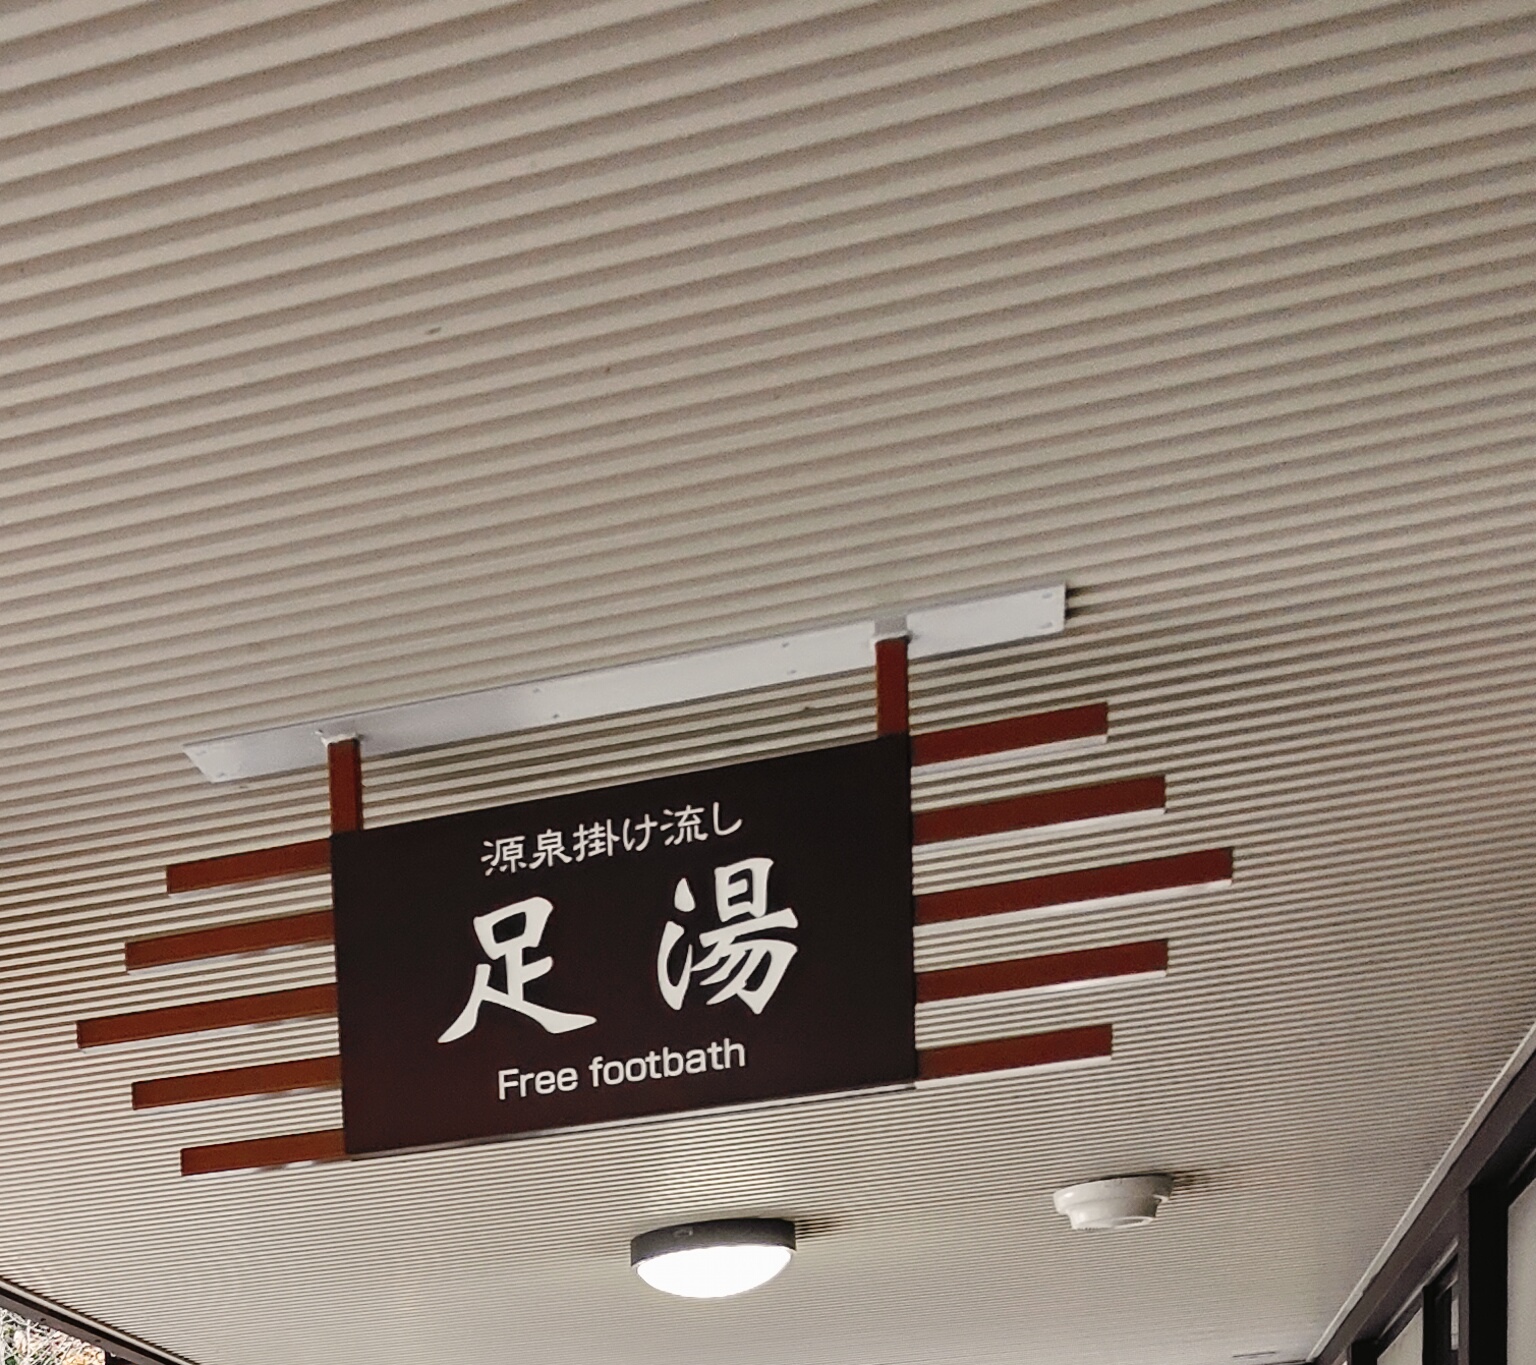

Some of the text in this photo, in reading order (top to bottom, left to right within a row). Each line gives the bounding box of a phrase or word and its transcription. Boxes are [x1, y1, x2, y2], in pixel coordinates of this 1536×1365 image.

[481, 802, 742, 876] 源泉掛け流し
[498, 1038, 745, 1099] Free footbath
